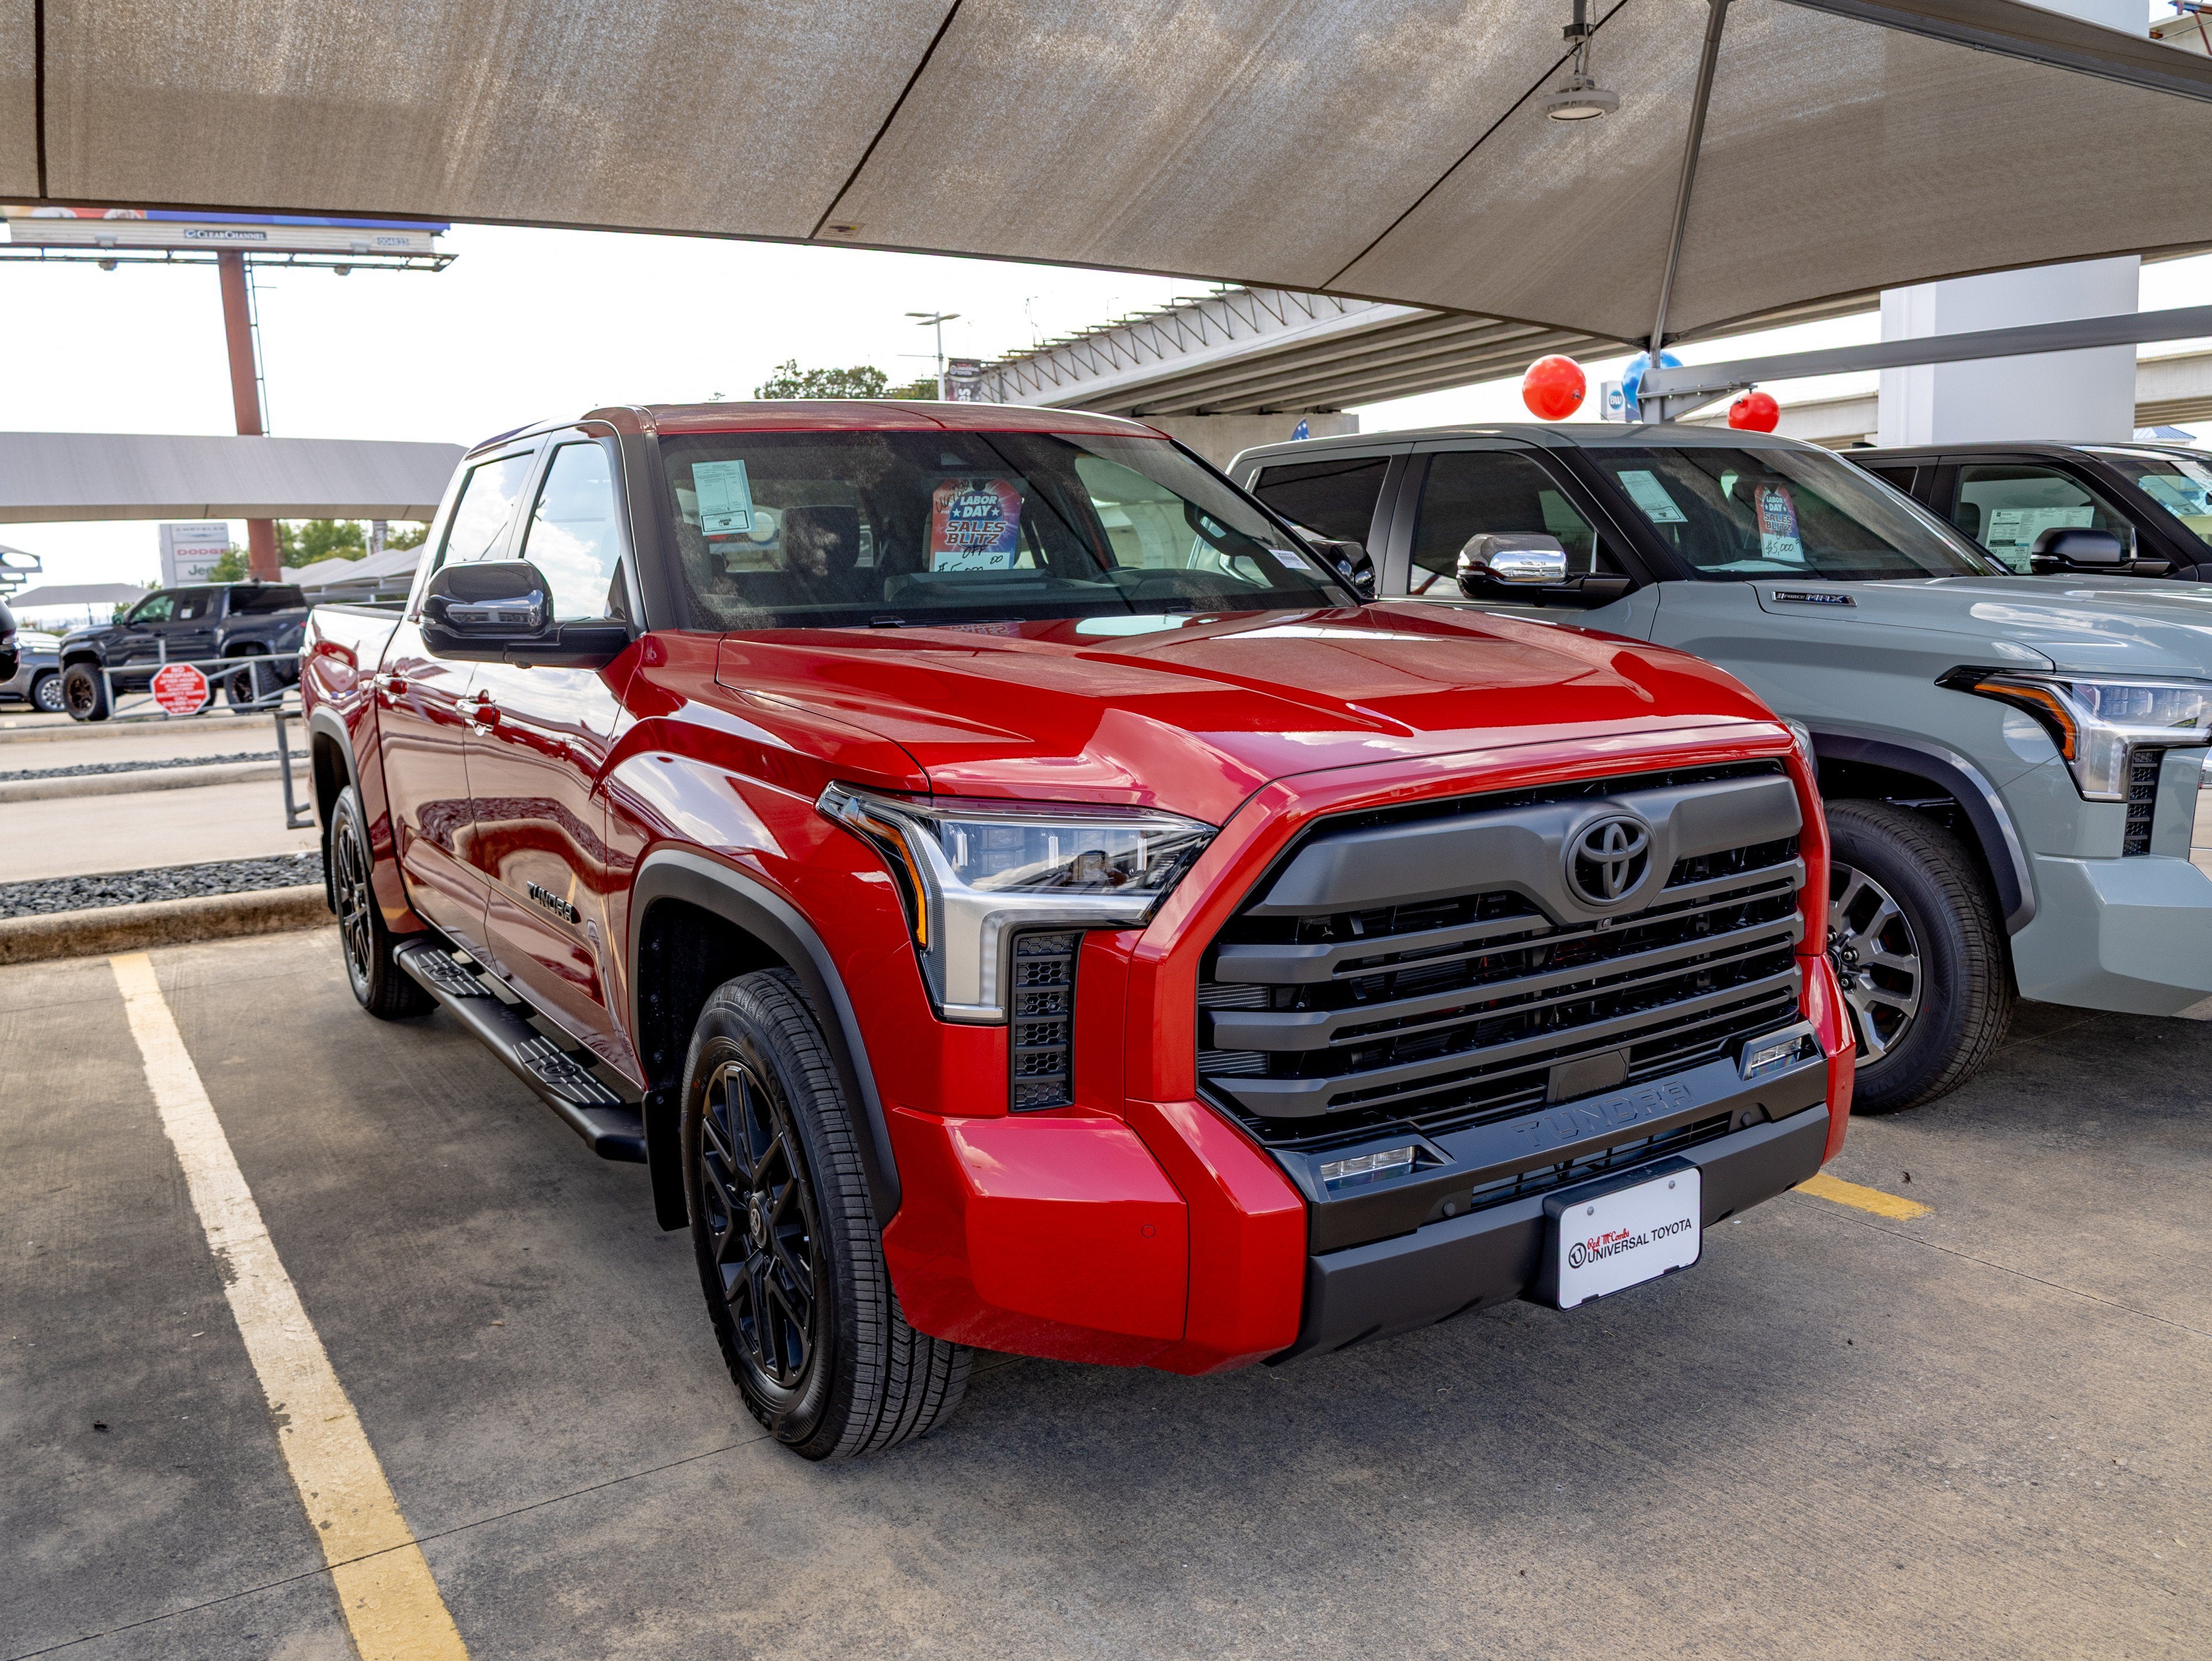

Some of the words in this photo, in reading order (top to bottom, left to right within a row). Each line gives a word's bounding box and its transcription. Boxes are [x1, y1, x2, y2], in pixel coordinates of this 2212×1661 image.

[960, 495, 998, 505] LABOR
[963, 505, 991, 517] DAY
[1769, 504, 1782, 512] DAY
[1764, 513, 1791, 523] SALES
[946, 521, 1006, 532] SALES
[1766, 521, 1791, 531] BLITZ
[946, 533, 1000, 544] BLITZ
[1805, 593, 1844, 603] MAX
[527, 880, 573, 924] TUNDRA
[1509, 1081, 1696, 1147] TUNDRA
[1587, 1238, 1600, 1252] Red
[1588, 1233, 1649, 1263] UNIVERSAL
[1651, 1218, 1692, 1241] TOYOTA
